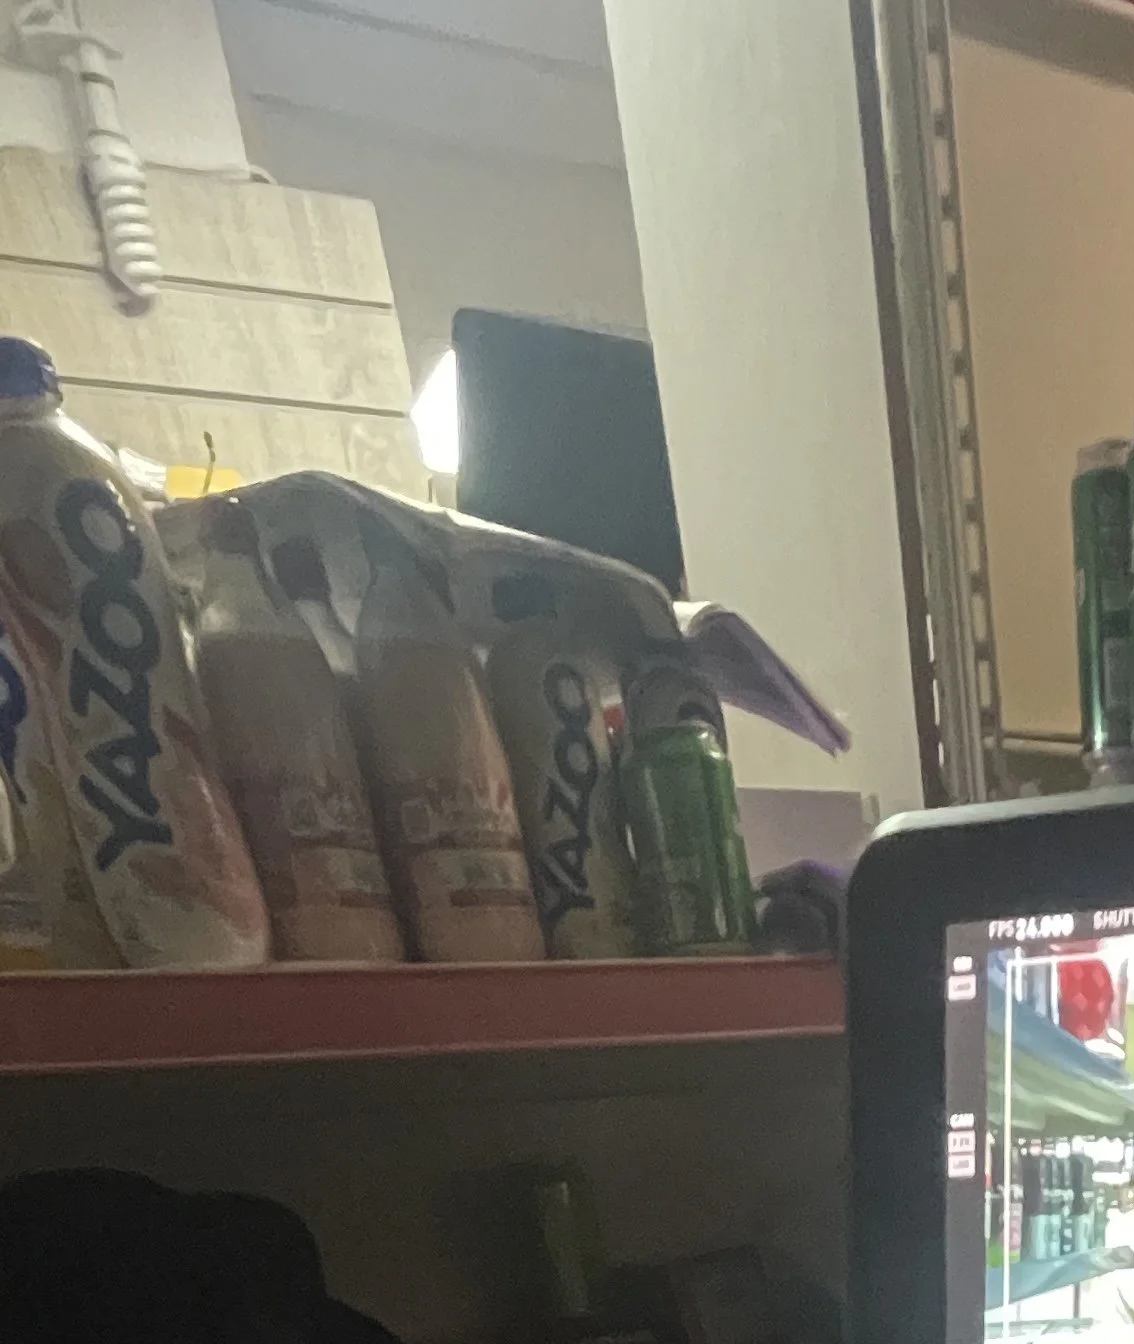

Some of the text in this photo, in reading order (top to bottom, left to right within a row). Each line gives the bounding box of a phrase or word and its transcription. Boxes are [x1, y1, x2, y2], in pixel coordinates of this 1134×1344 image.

[55, 478, 174, 872] YAZOO
[533, 662, 599, 938] YAZOO
[988, 919, 1014, 939] FPS
